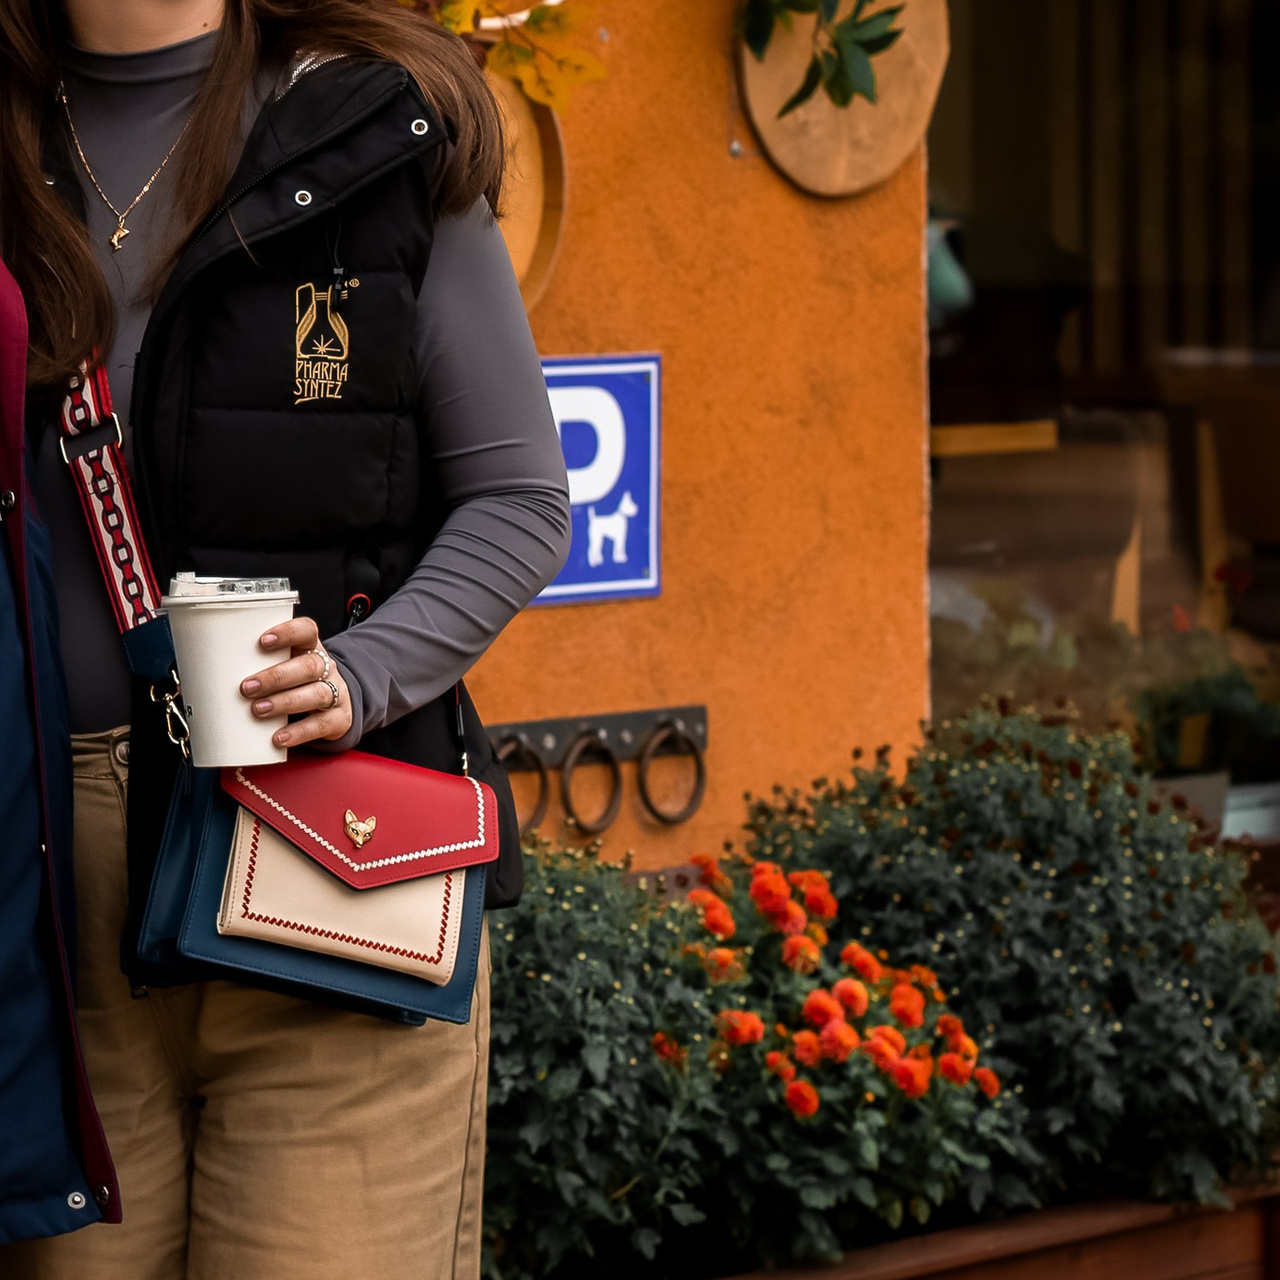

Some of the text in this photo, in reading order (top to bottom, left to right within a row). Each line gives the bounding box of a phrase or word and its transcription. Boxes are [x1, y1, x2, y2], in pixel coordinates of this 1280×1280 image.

[296, 359, 349, 381] PHARMA
[293, 378, 342, 402] SYNTEZ
[547, 386, 626, 505] P
